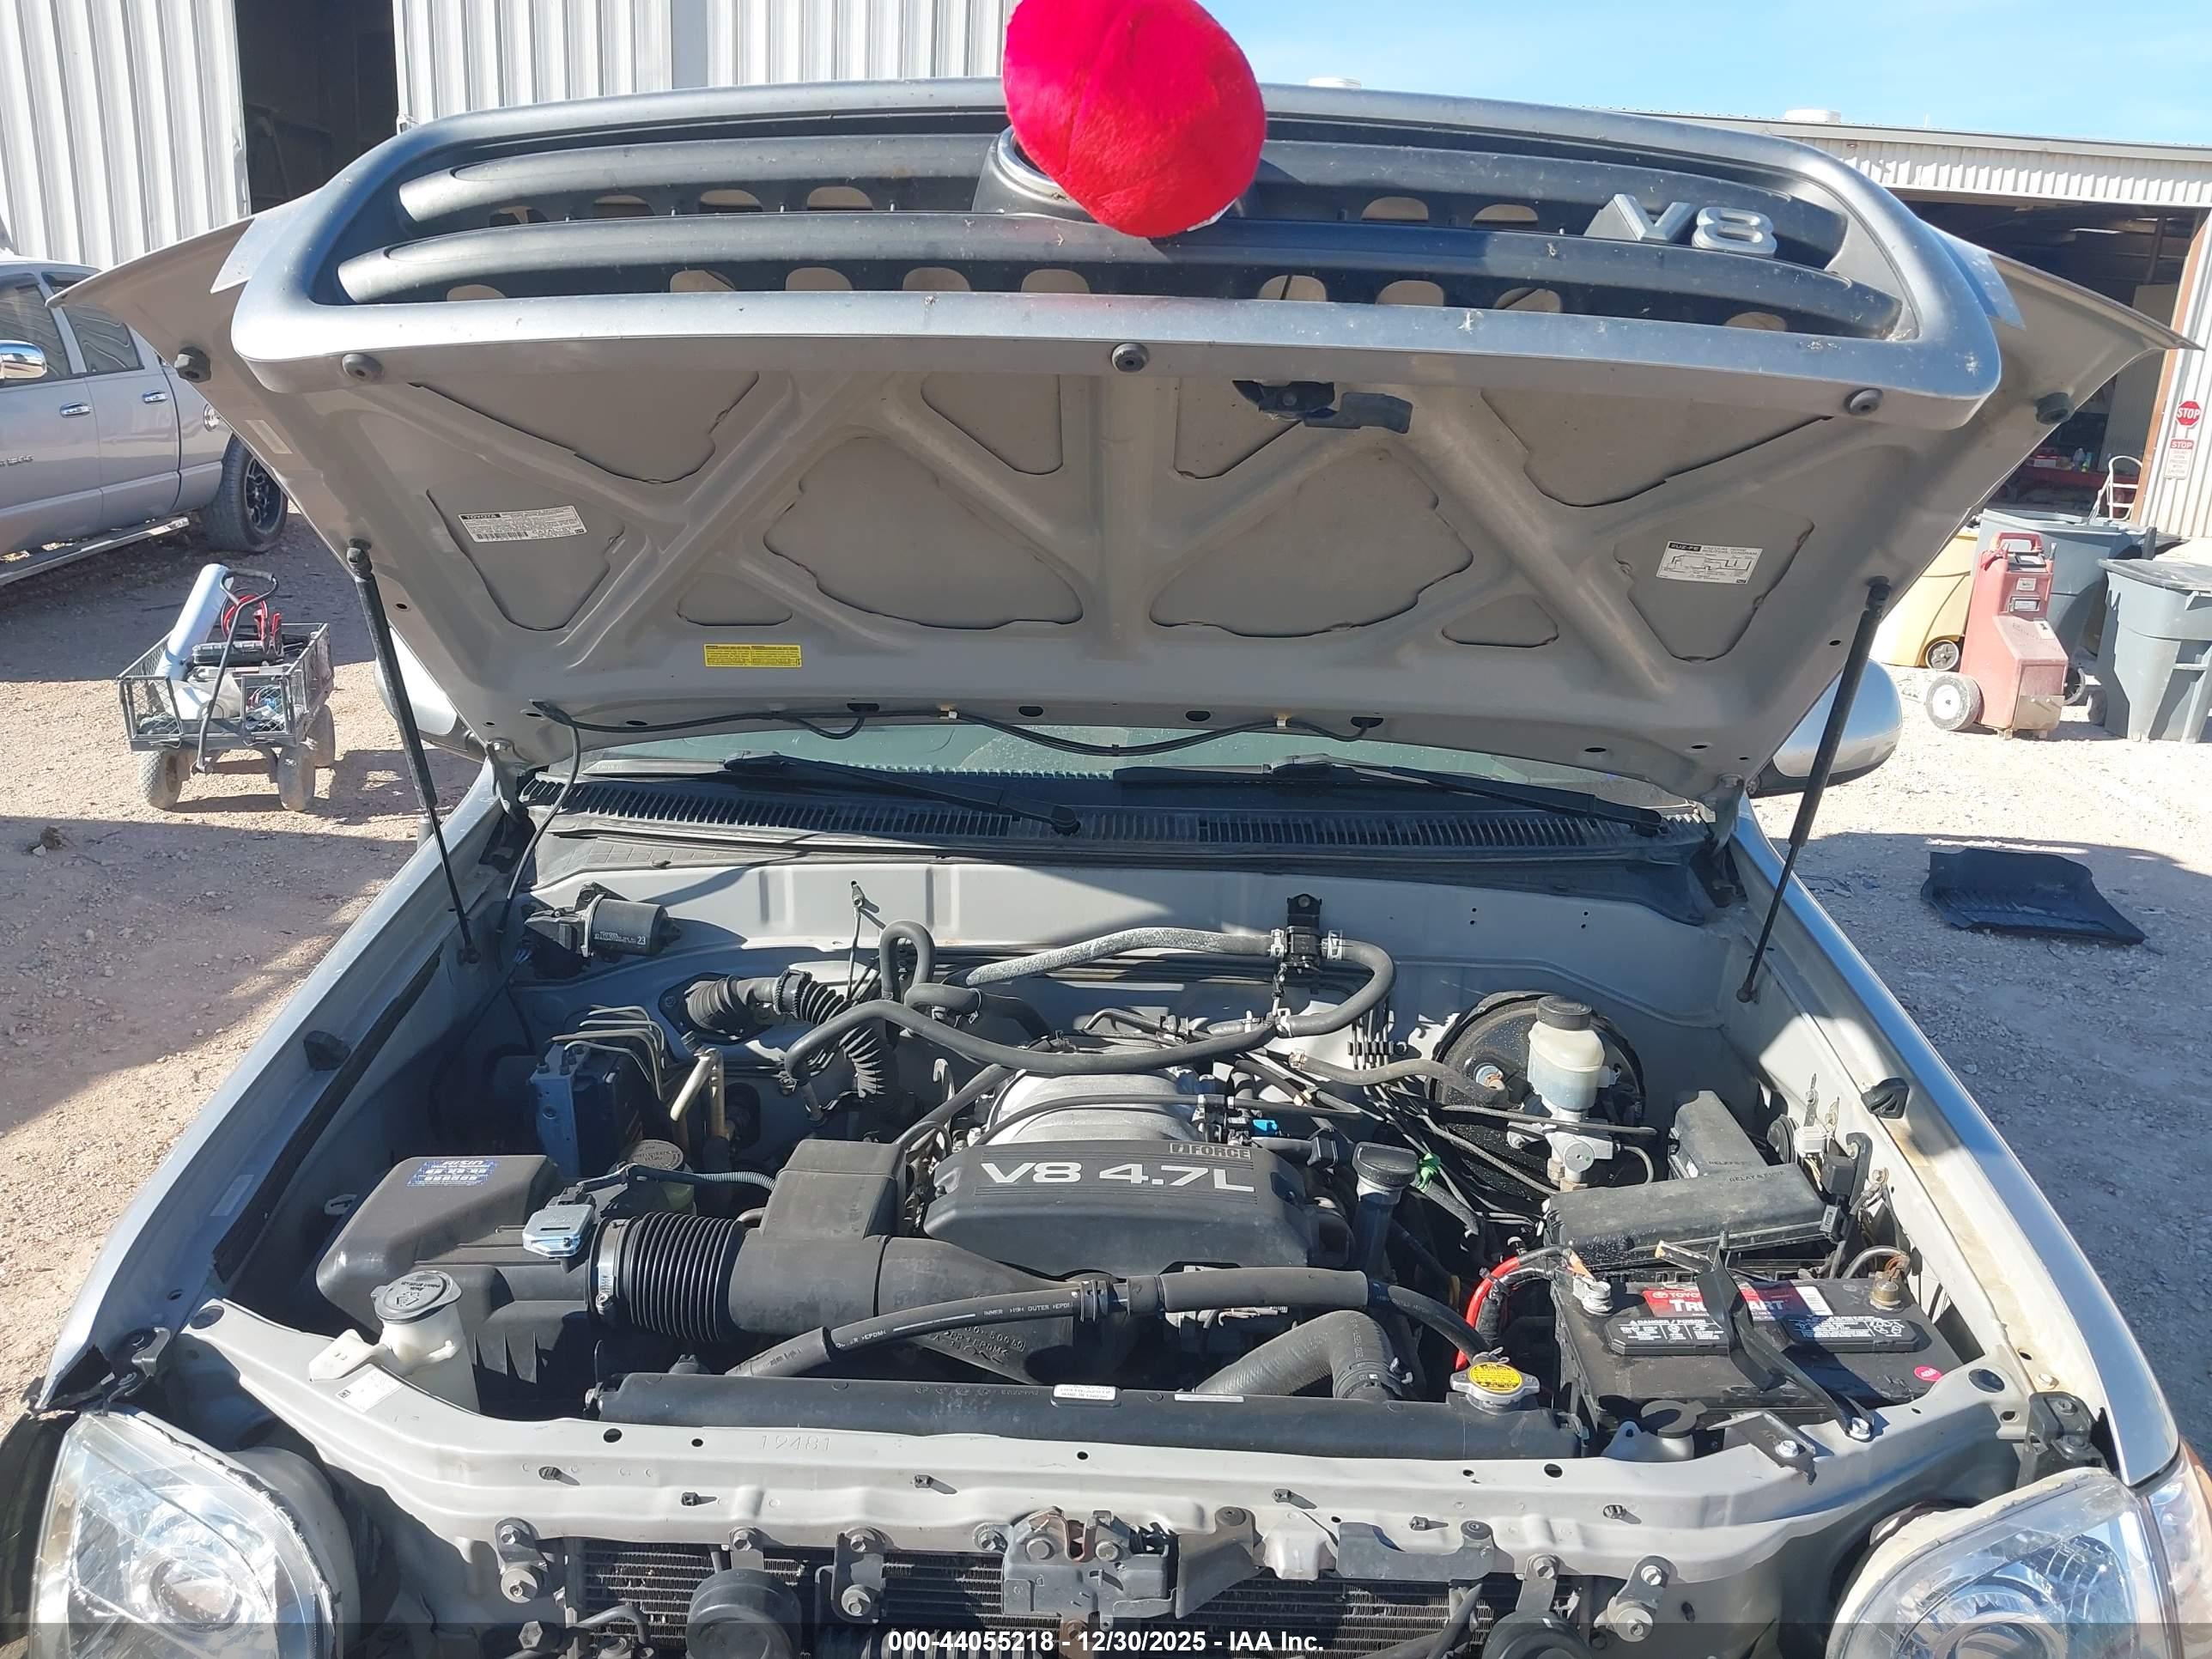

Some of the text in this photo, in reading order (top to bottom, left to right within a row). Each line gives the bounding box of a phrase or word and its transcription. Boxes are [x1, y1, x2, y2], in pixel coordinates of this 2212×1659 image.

[1611, 193, 1778, 255] V8
[2177, 408, 2201, 420] STOP
[981, 1162, 1255, 1192] V8 4.7L
